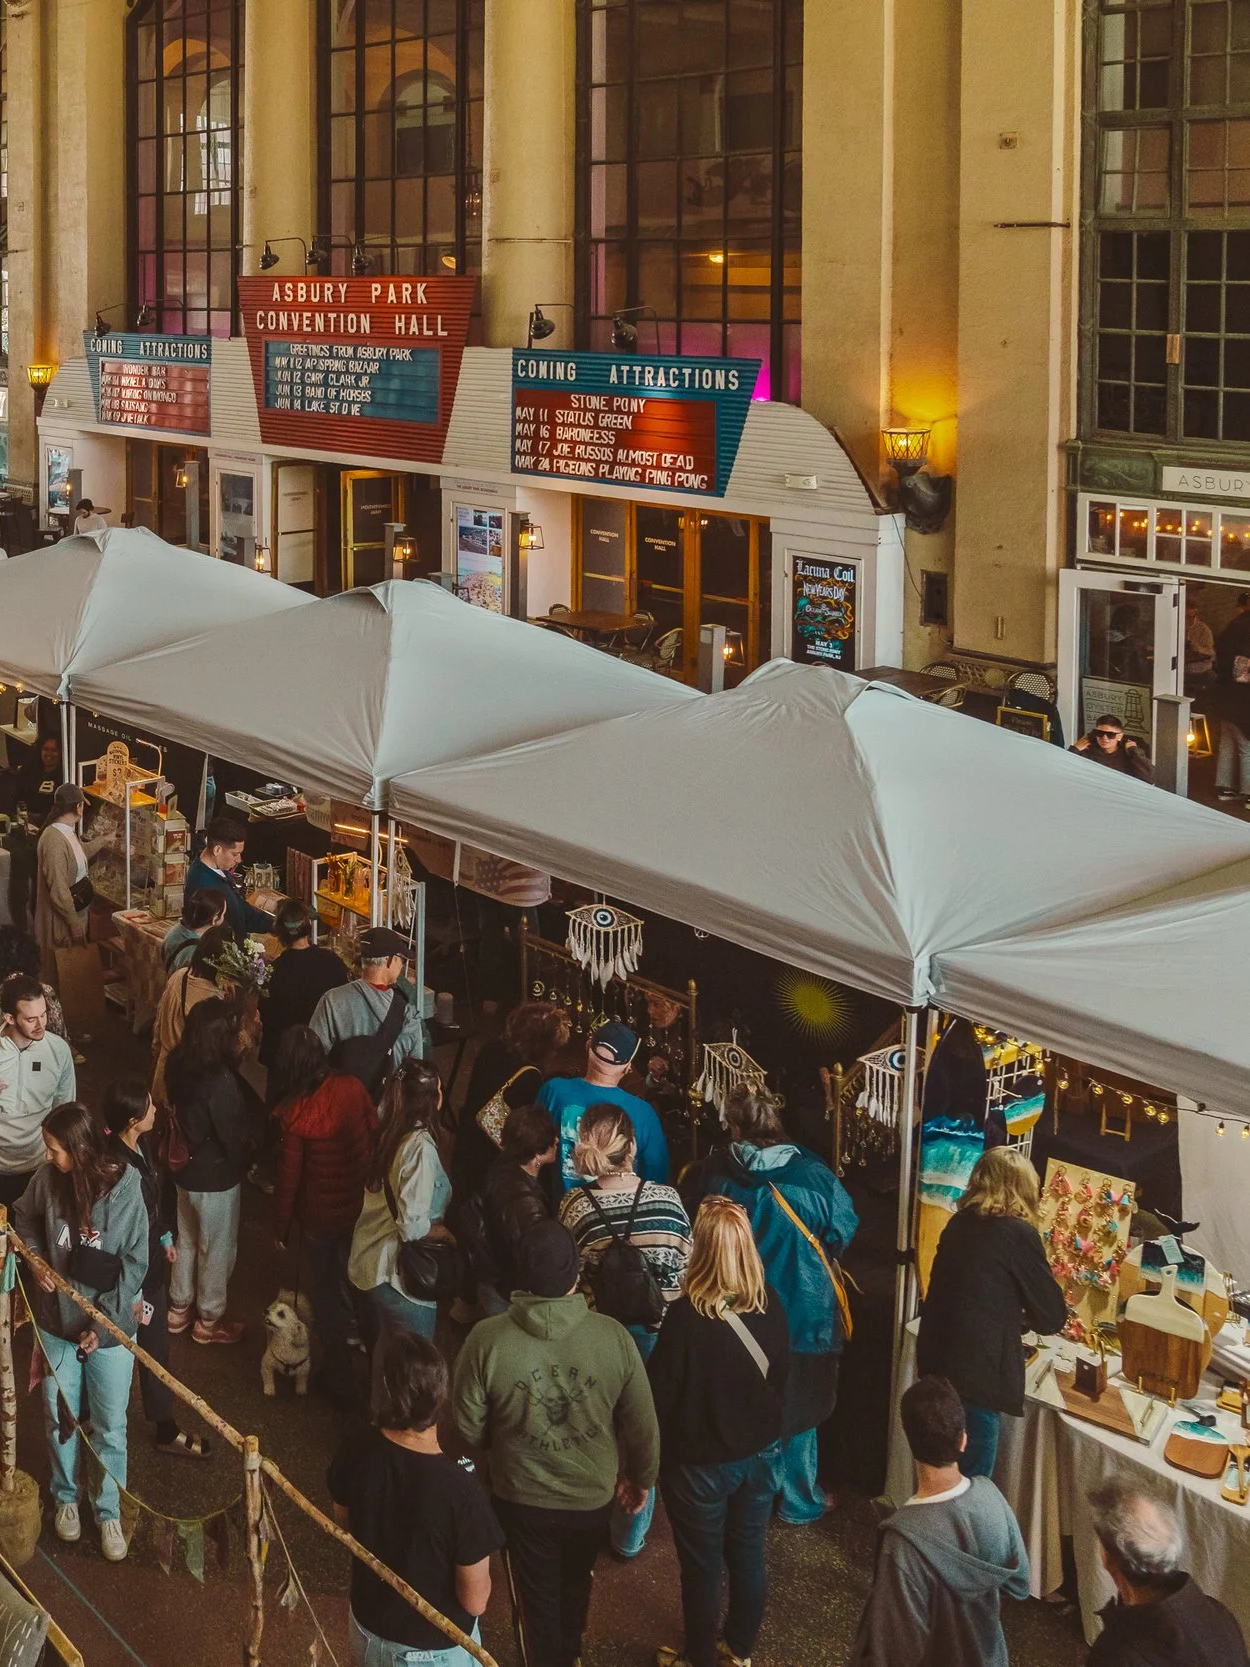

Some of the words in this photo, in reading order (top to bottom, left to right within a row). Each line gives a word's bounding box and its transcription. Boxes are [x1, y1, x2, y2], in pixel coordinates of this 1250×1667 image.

[272, 282, 348, 303] ASBURY
[371, 283, 428, 304] PARK
[256, 310, 371, 334] CONVENTION
[395, 314, 448, 336] HALL
[90, 339, 123, 354] COMING
[139, 341, 208, 359] ATTRACTIONS
[290, 344, 330, 357] GREETINGS
[333, 345, 354, 358] FROM
[357, 346, 388, 360] ASBURY
[390, 348, 413, 361] PARK
[123, 364, 149, 376] WONDER
[305, 358, 317, 370] AP
[320, 359, 347, 372] SPRING
[348, 360, 380, 374] BAZAAR
[517, 359, 576, 382] COMING
[609, 364, 739, 390] ATTRACTIONS
[276, 370, 291, 382] JUN
[293, 371, 301, 383] 12
[304, 372, 325, 384] GARY
[328, 373, 356, 387] CLARK
[358, 375, 370, 388] JR
[275, 384, 291, 396] JUN
[293, 385, 302, 397] 13
[305, 386, 325, 398] BAND
[327, 387, 339, 399] OF
[340, 388, 371, 403] HORSES
[275, 397, 291, 410] JUN
[305, 400, 327, 412] LAKE
[329, 402, 340, 414] ST
[571, 394, 609, 411] STONE
[613, 397, 646, 414] PONY
[515, 407, 535, 421] MAY
[539, 408, 548, 422] 11
[555, 410, 595, 426] STATUS
[598, 414, 633, 430] GREEN
[515, 423, 536, 438] MAY
[539, 424, 550, 439] 16
[556, 426, 616, 444] BARONEESS
[515, 439, 533, 454] MAY
[538, 441, 550, 455] 17
[553, 443, 572, 458] JOE
[574, 445, 614, 462] RUSSOS
[616, 449, 659, 467] ALMOST
[661, 452, 694, 470] DEAD
[515, 455, 537, 470] MAY
[538, 457, 550, 471] 24
[553, 459, 596, 477] PIGEONS
[598, 463, 641, 482] PLAYING
[645, 469, 672, 485] PING
[674, 472, 708, 490] PONG
[1178, 474, 1250, 492] ASBUR
[644, 537, 676, 547] CONVENTION
[795, 560, 830, 578] Lacuna
[834, 566, 855, 582] Coil
[1086, 690, 1123, 701] ASBURY
[87, 721, 119, 737] MASSAGE
[514, 1365, 597, 1390] OCEAN
